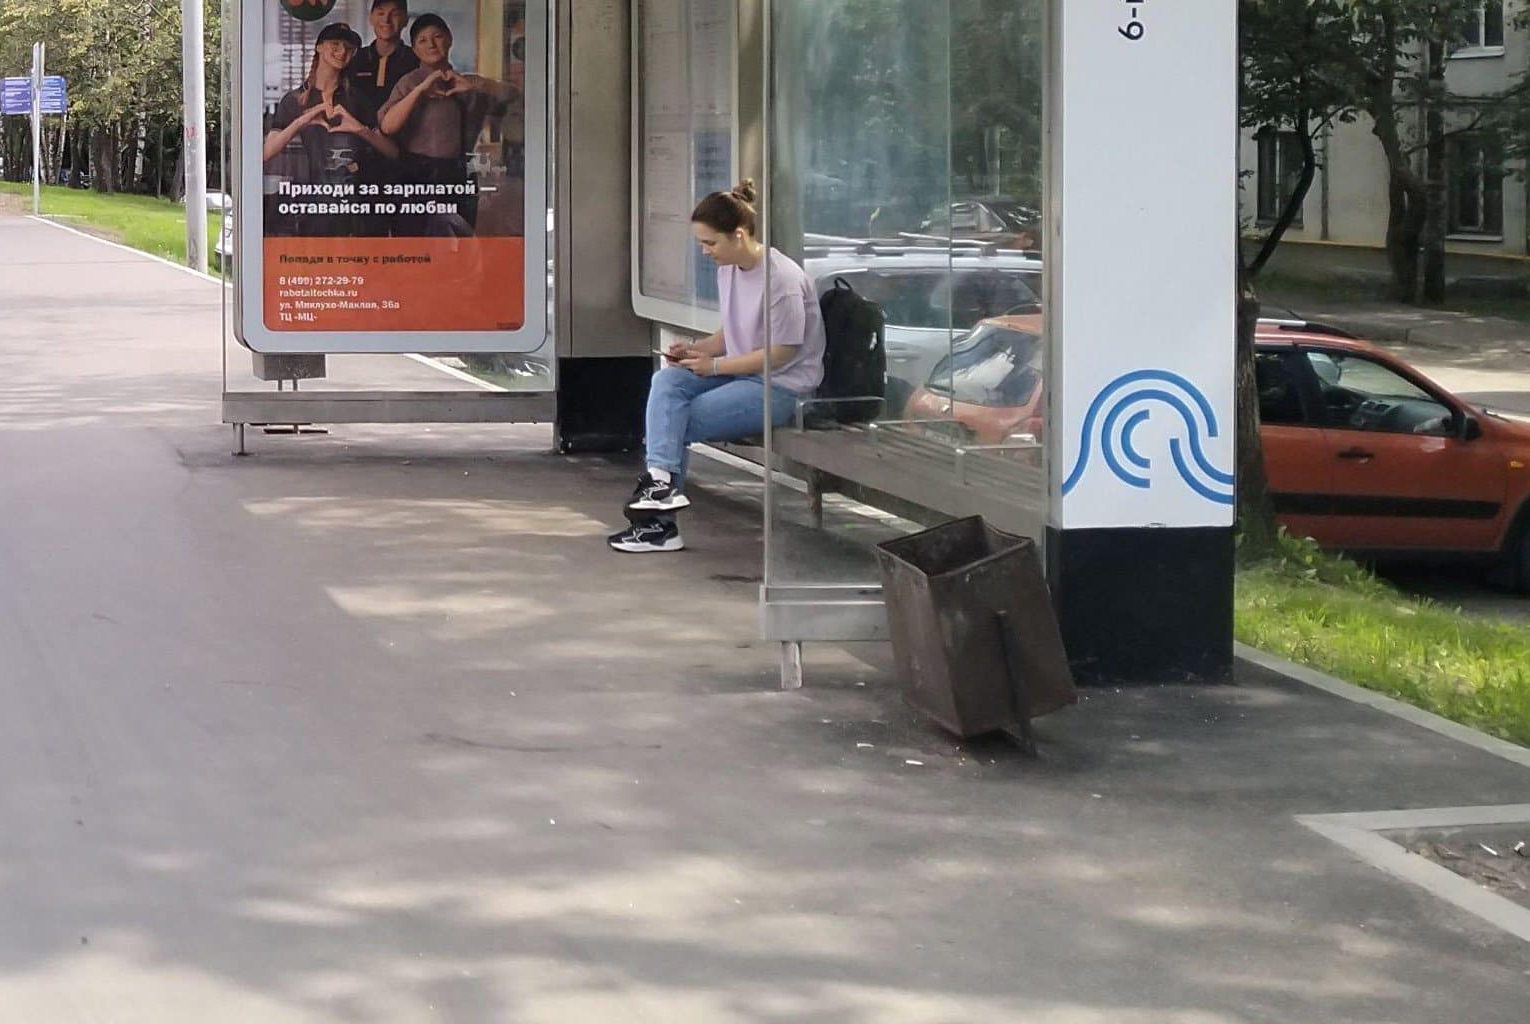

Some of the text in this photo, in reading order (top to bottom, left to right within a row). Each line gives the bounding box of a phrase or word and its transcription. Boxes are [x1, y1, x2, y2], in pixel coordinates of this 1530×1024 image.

[278, 181, 355, 198] Приходи
[358, 185, 379, 195] за
[383, 180, 476, 198] зарплатой
[278, 199, 458, 215] оставайся по любви
[337, 256, 370, 265] точку
[382, 253, 432, 265] работой
[315, 276, 365, 286] 272-29-79
[279, 301, 293, 312] ул.
[381, 300, 401, 310] 36а
[279, 312, 292, 322] ТЦ
